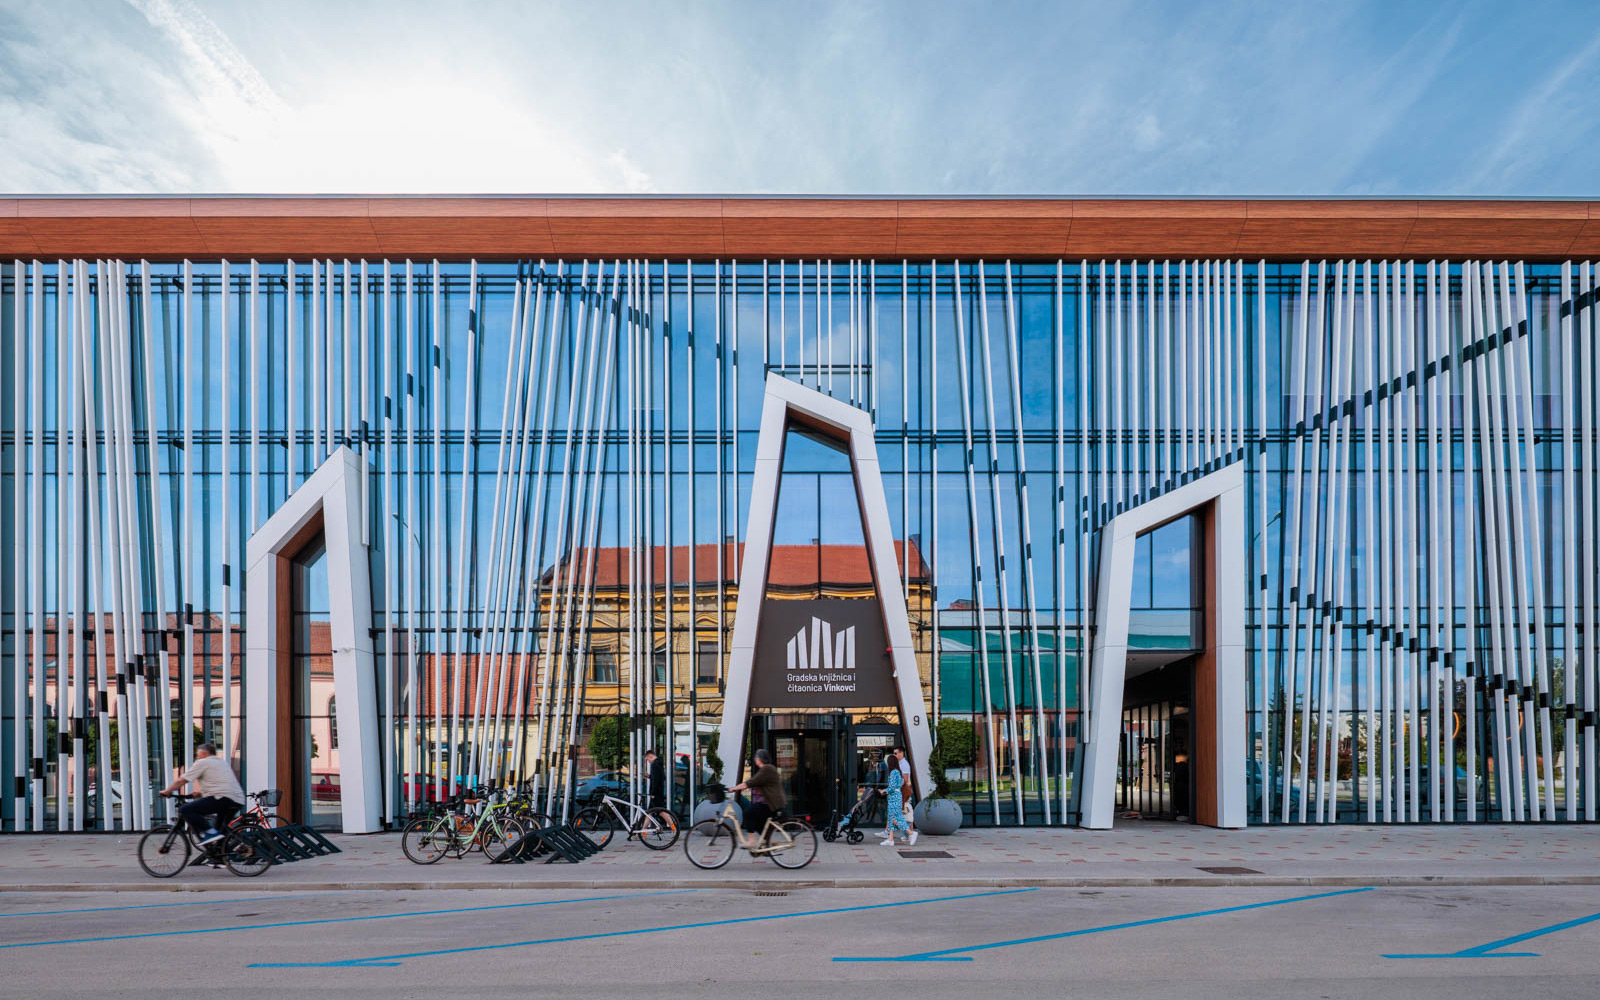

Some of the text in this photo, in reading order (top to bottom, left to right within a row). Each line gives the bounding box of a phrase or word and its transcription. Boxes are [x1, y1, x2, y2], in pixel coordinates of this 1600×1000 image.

[787, 673, 856, 683] Gradska knjižnica i
[787, 683, 856, 692] čitaonica Vinkovci
[913, 715, 920, 726] 9
